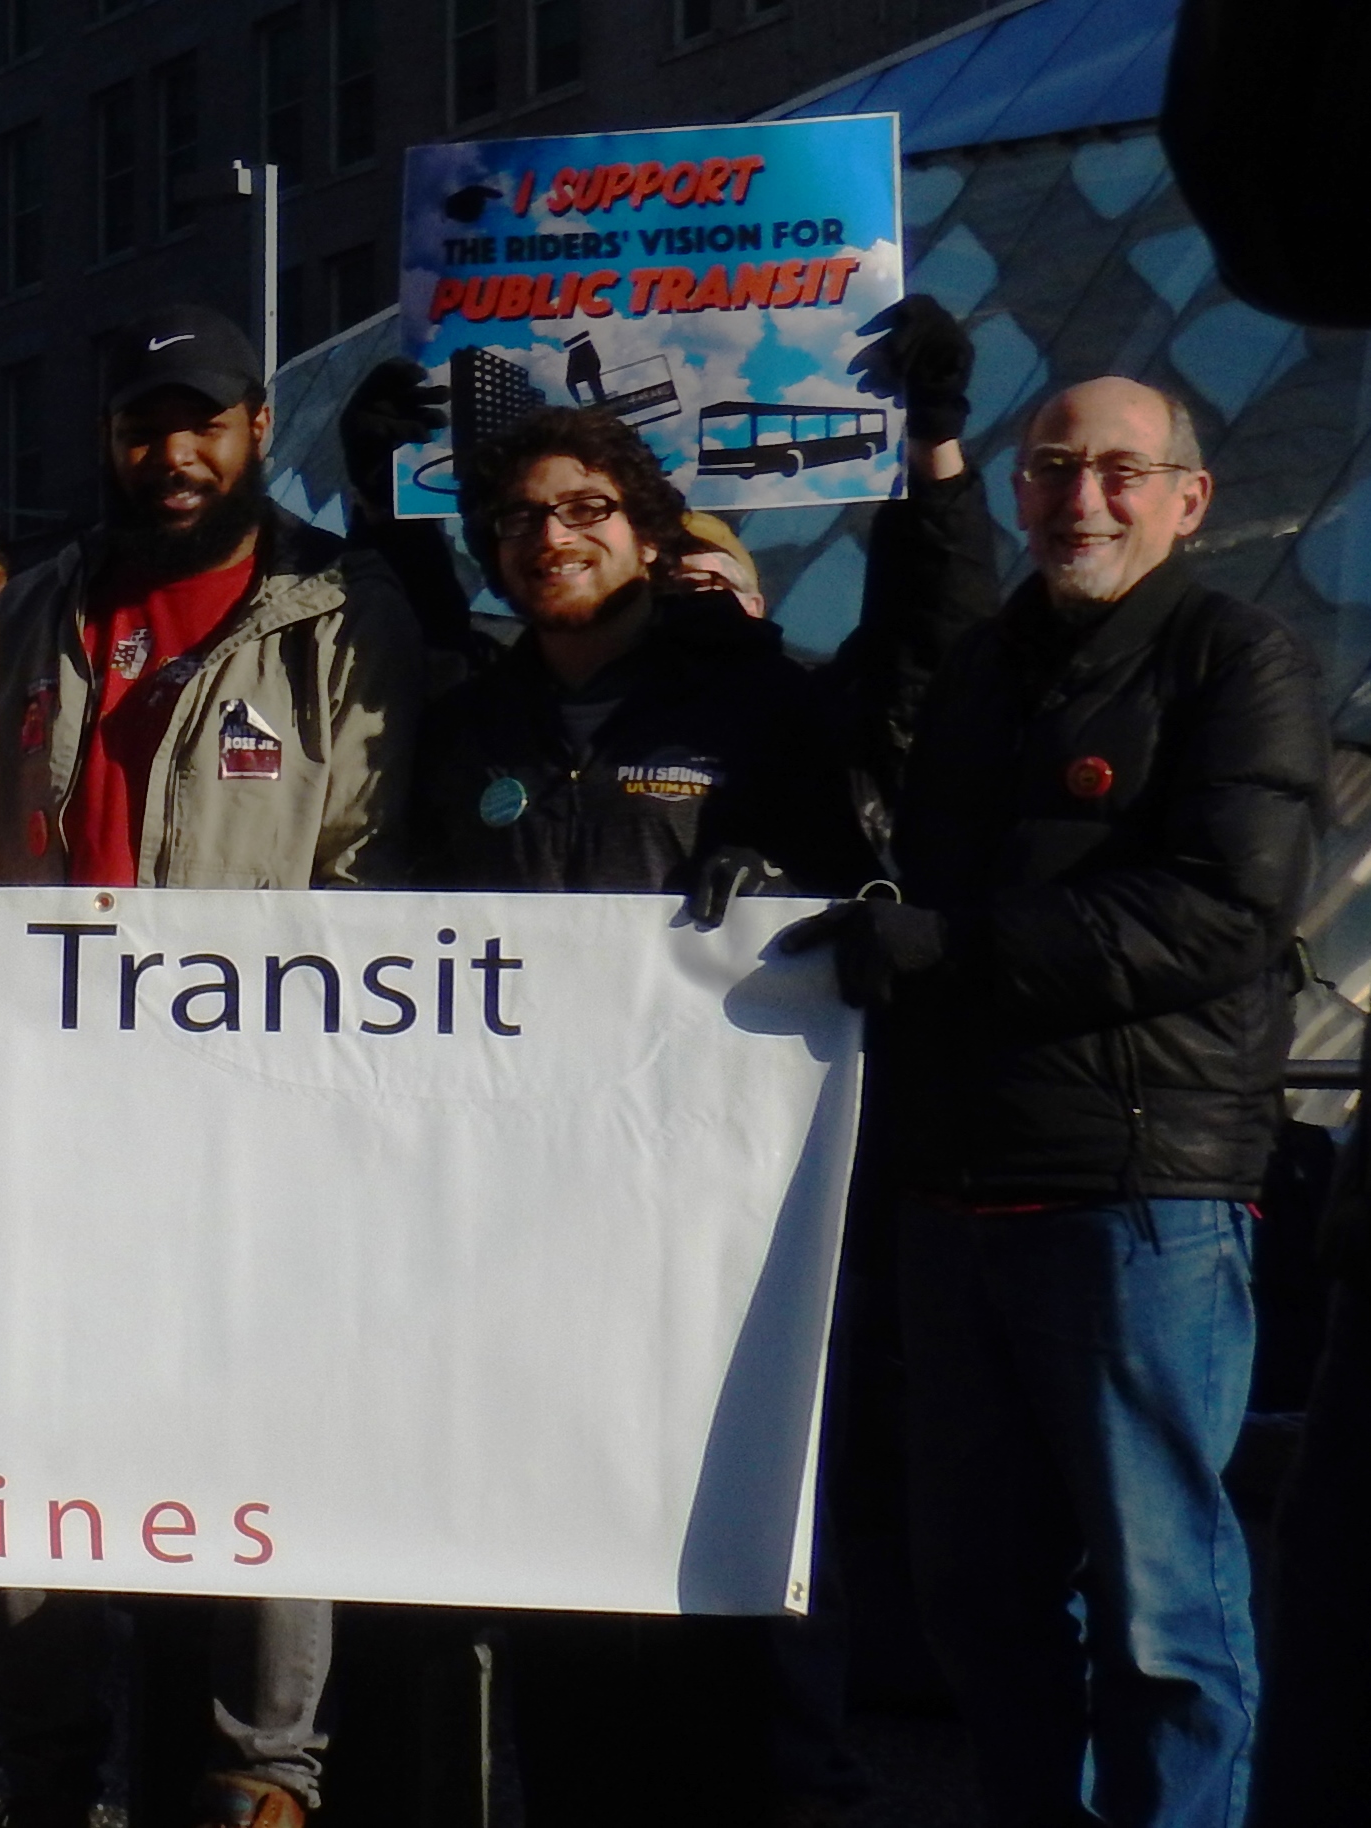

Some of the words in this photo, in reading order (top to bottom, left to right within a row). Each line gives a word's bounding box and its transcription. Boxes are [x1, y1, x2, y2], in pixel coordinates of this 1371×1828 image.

[513, 170, 535, 218] I
[547, 156, 765, 216] SUPPORT
[443, 235, 497, 267] THE
[505, 229, 631, 265] RIDERS'
[637, 222, 763, 257] VISION
[771, 217, 845, 249] FOR
[429, 267, 621, 324] PUBLIC
[628, 257, 860, 318] TRANSIT
[26, 922, 525, 1037] Transit
